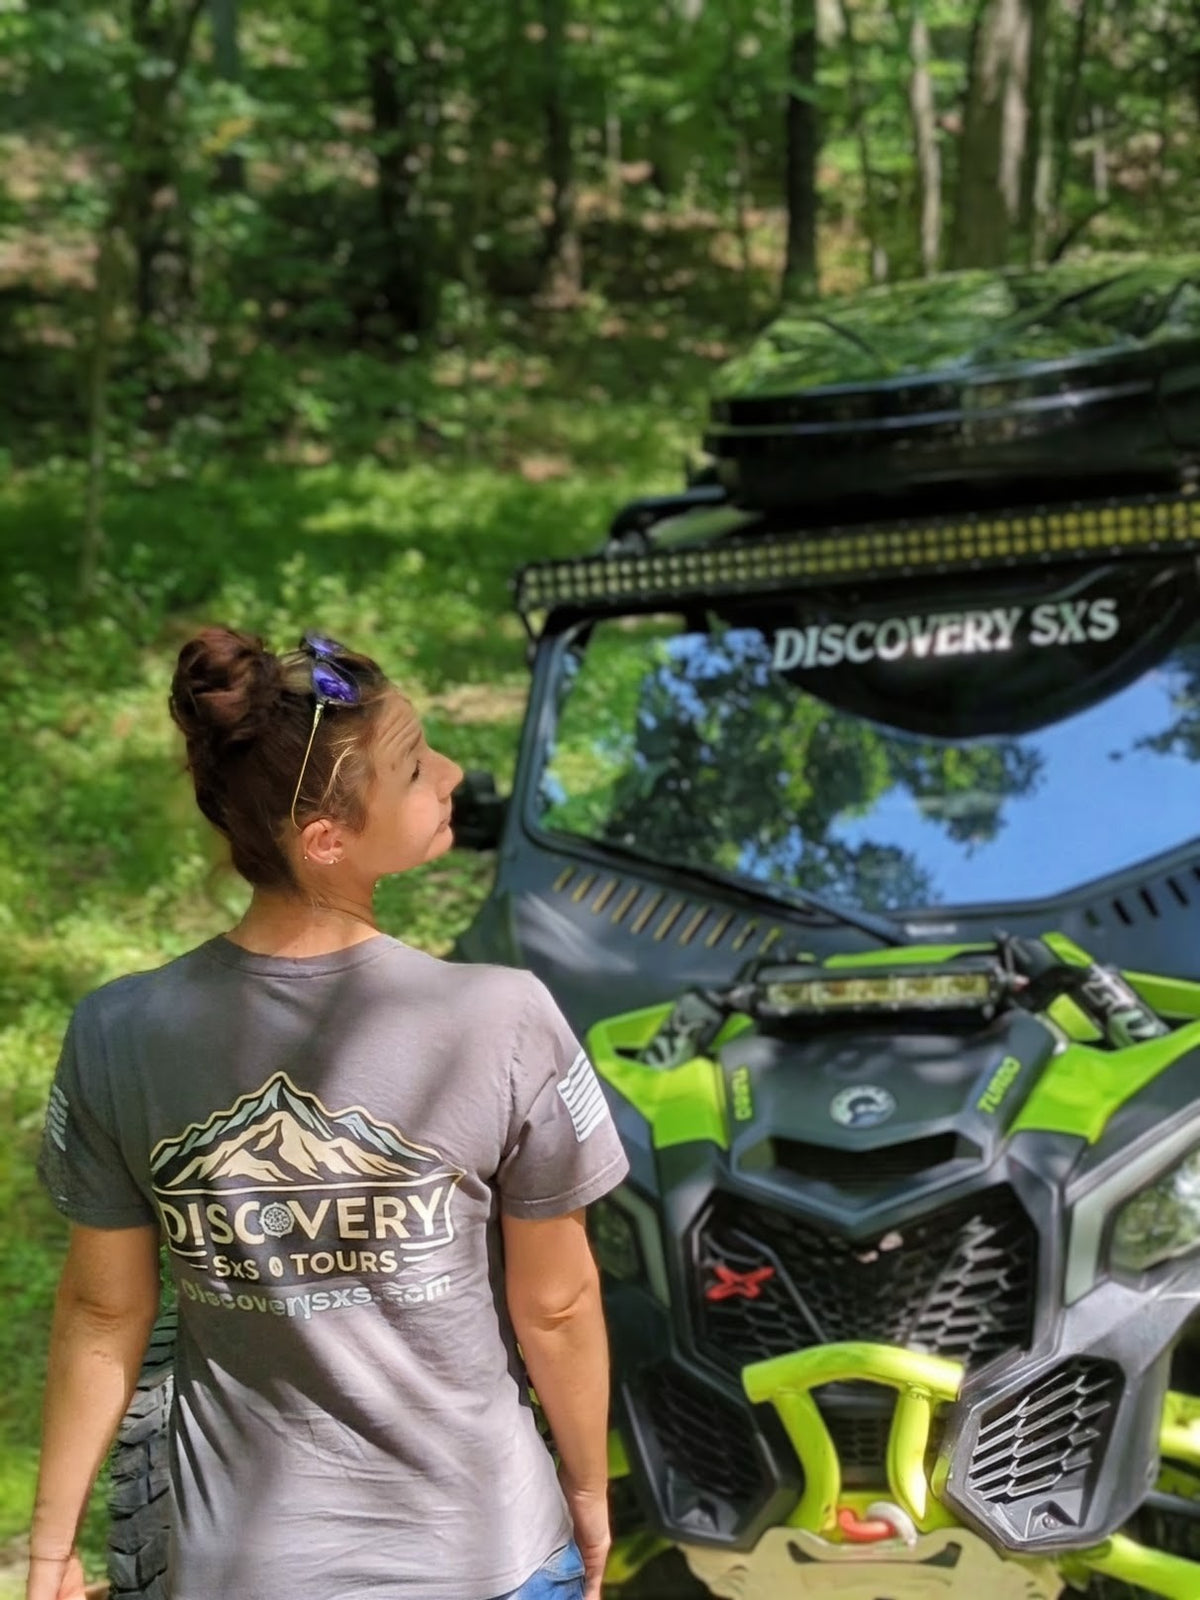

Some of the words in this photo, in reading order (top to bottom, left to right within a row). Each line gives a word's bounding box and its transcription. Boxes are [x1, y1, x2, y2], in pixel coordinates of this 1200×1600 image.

[772, 607, 1021, 671] DISCOVERY
[1029, 599, 1119, 646] SXS
[158, 1186, 444, 1246] DISCOVERY
[290, 1250, 398, 1276] TOURS
